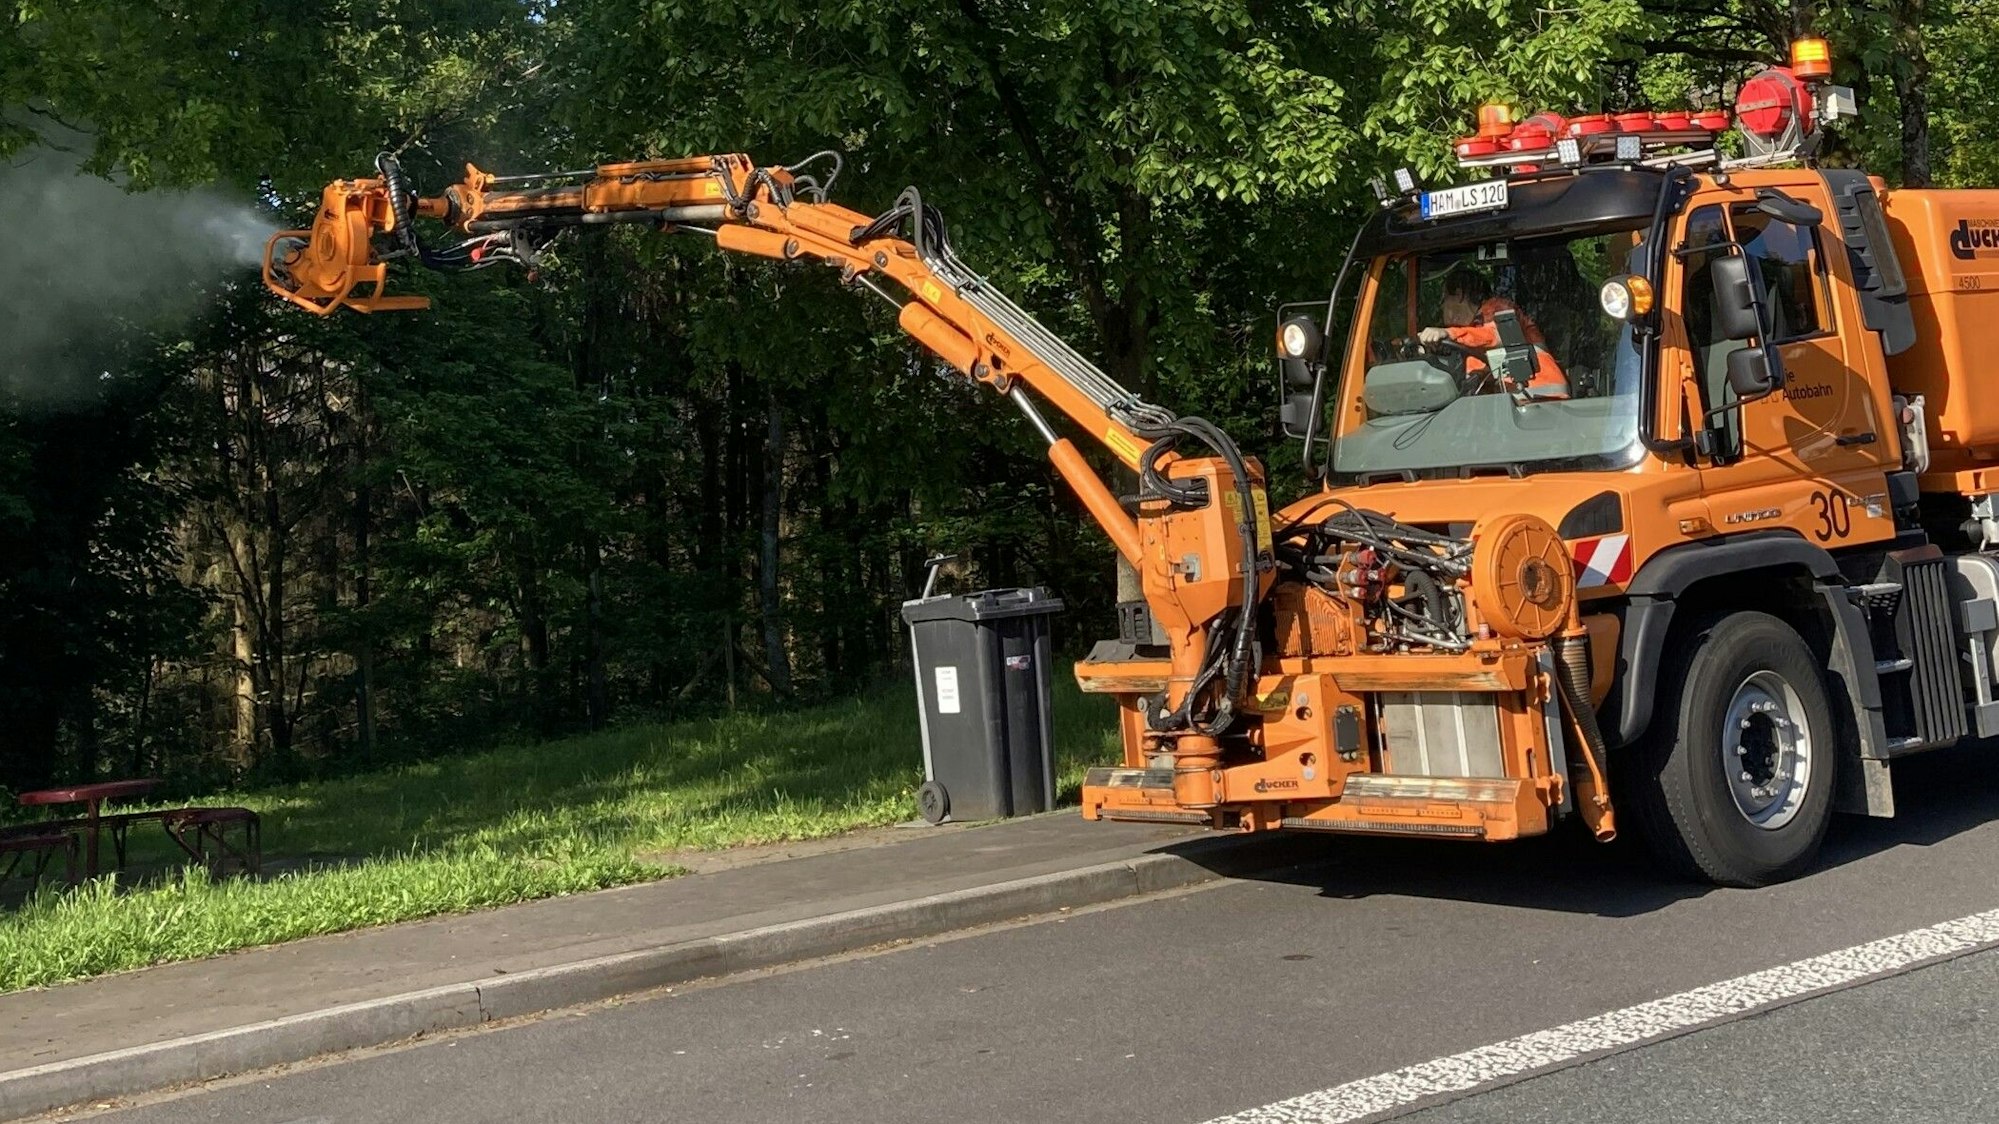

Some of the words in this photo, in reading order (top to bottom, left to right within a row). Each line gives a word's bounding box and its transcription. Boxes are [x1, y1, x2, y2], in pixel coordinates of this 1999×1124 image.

[1430, 192, 1454, 213] HAM
[1461, 188, 1478, 208] LS
[1480, 183, 1505, 205] 120
[1958, 275, 1981, 289] 4500
[1782, 382, 1834, 402] Autobahn
[1810, 488, 1850, 542] 30
